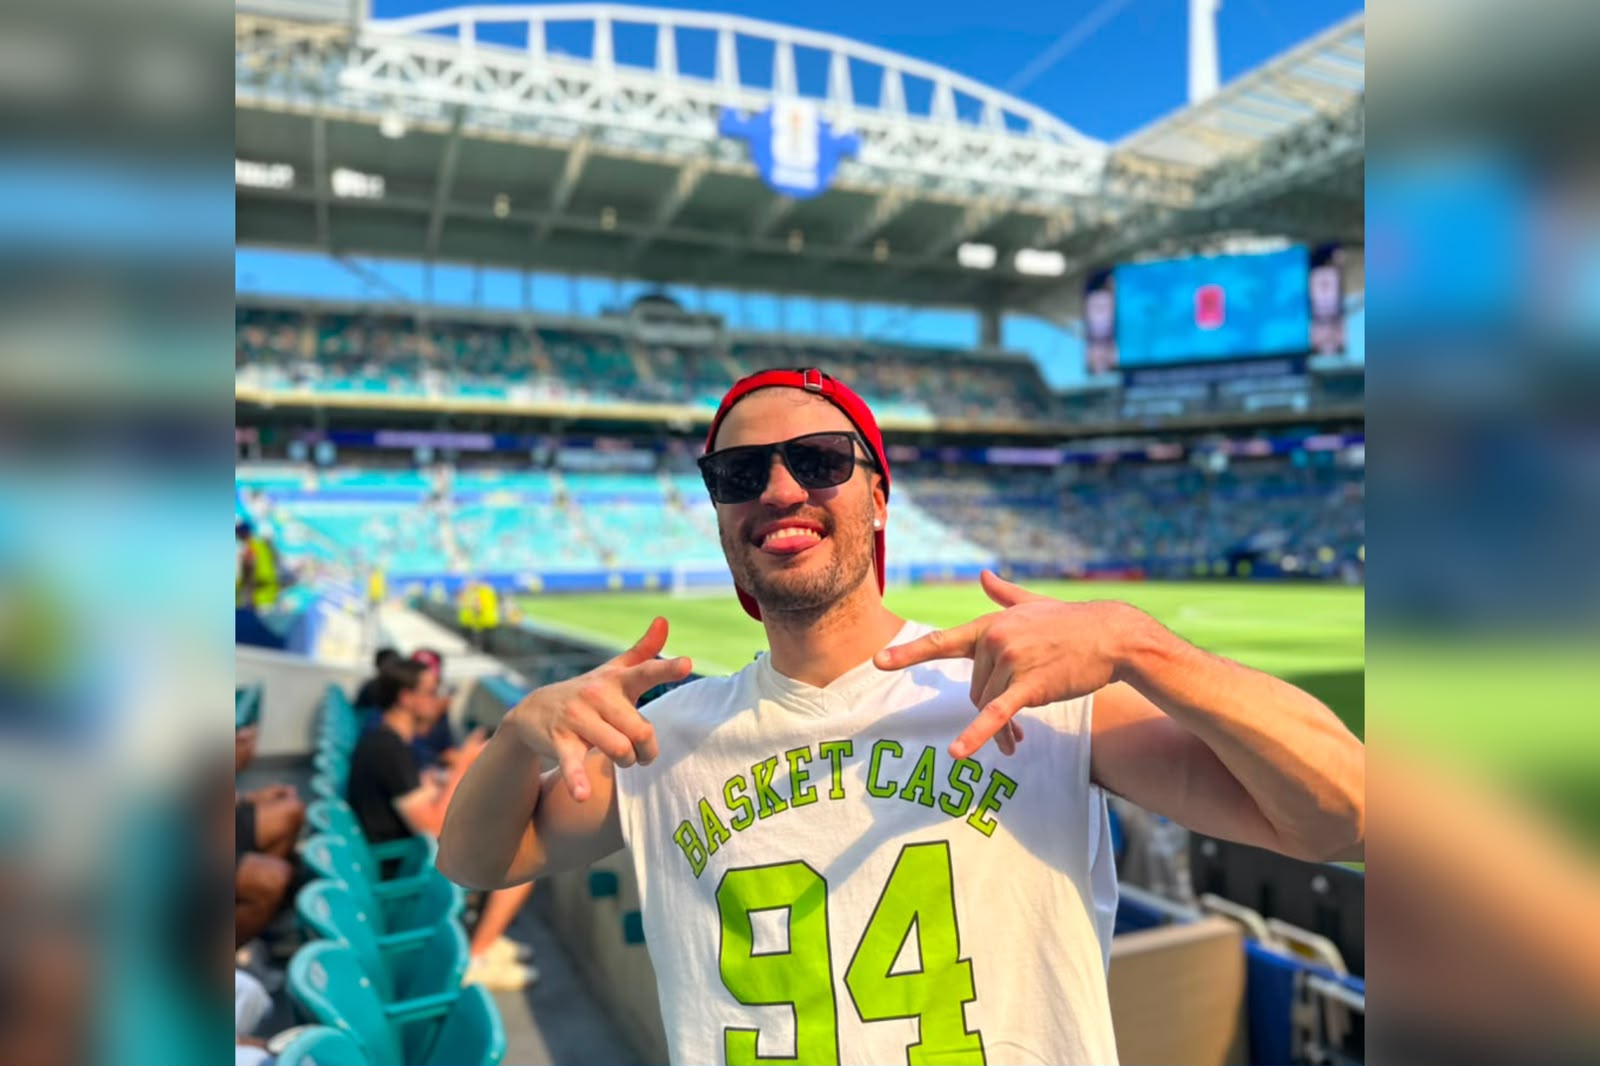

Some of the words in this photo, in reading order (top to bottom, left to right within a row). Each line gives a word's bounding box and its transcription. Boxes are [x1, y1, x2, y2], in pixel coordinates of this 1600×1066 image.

[673, 740, 853, 878] BASKET
[866, 739, 1018, 837] CASE
[715, 840, 987, 1066] 94
